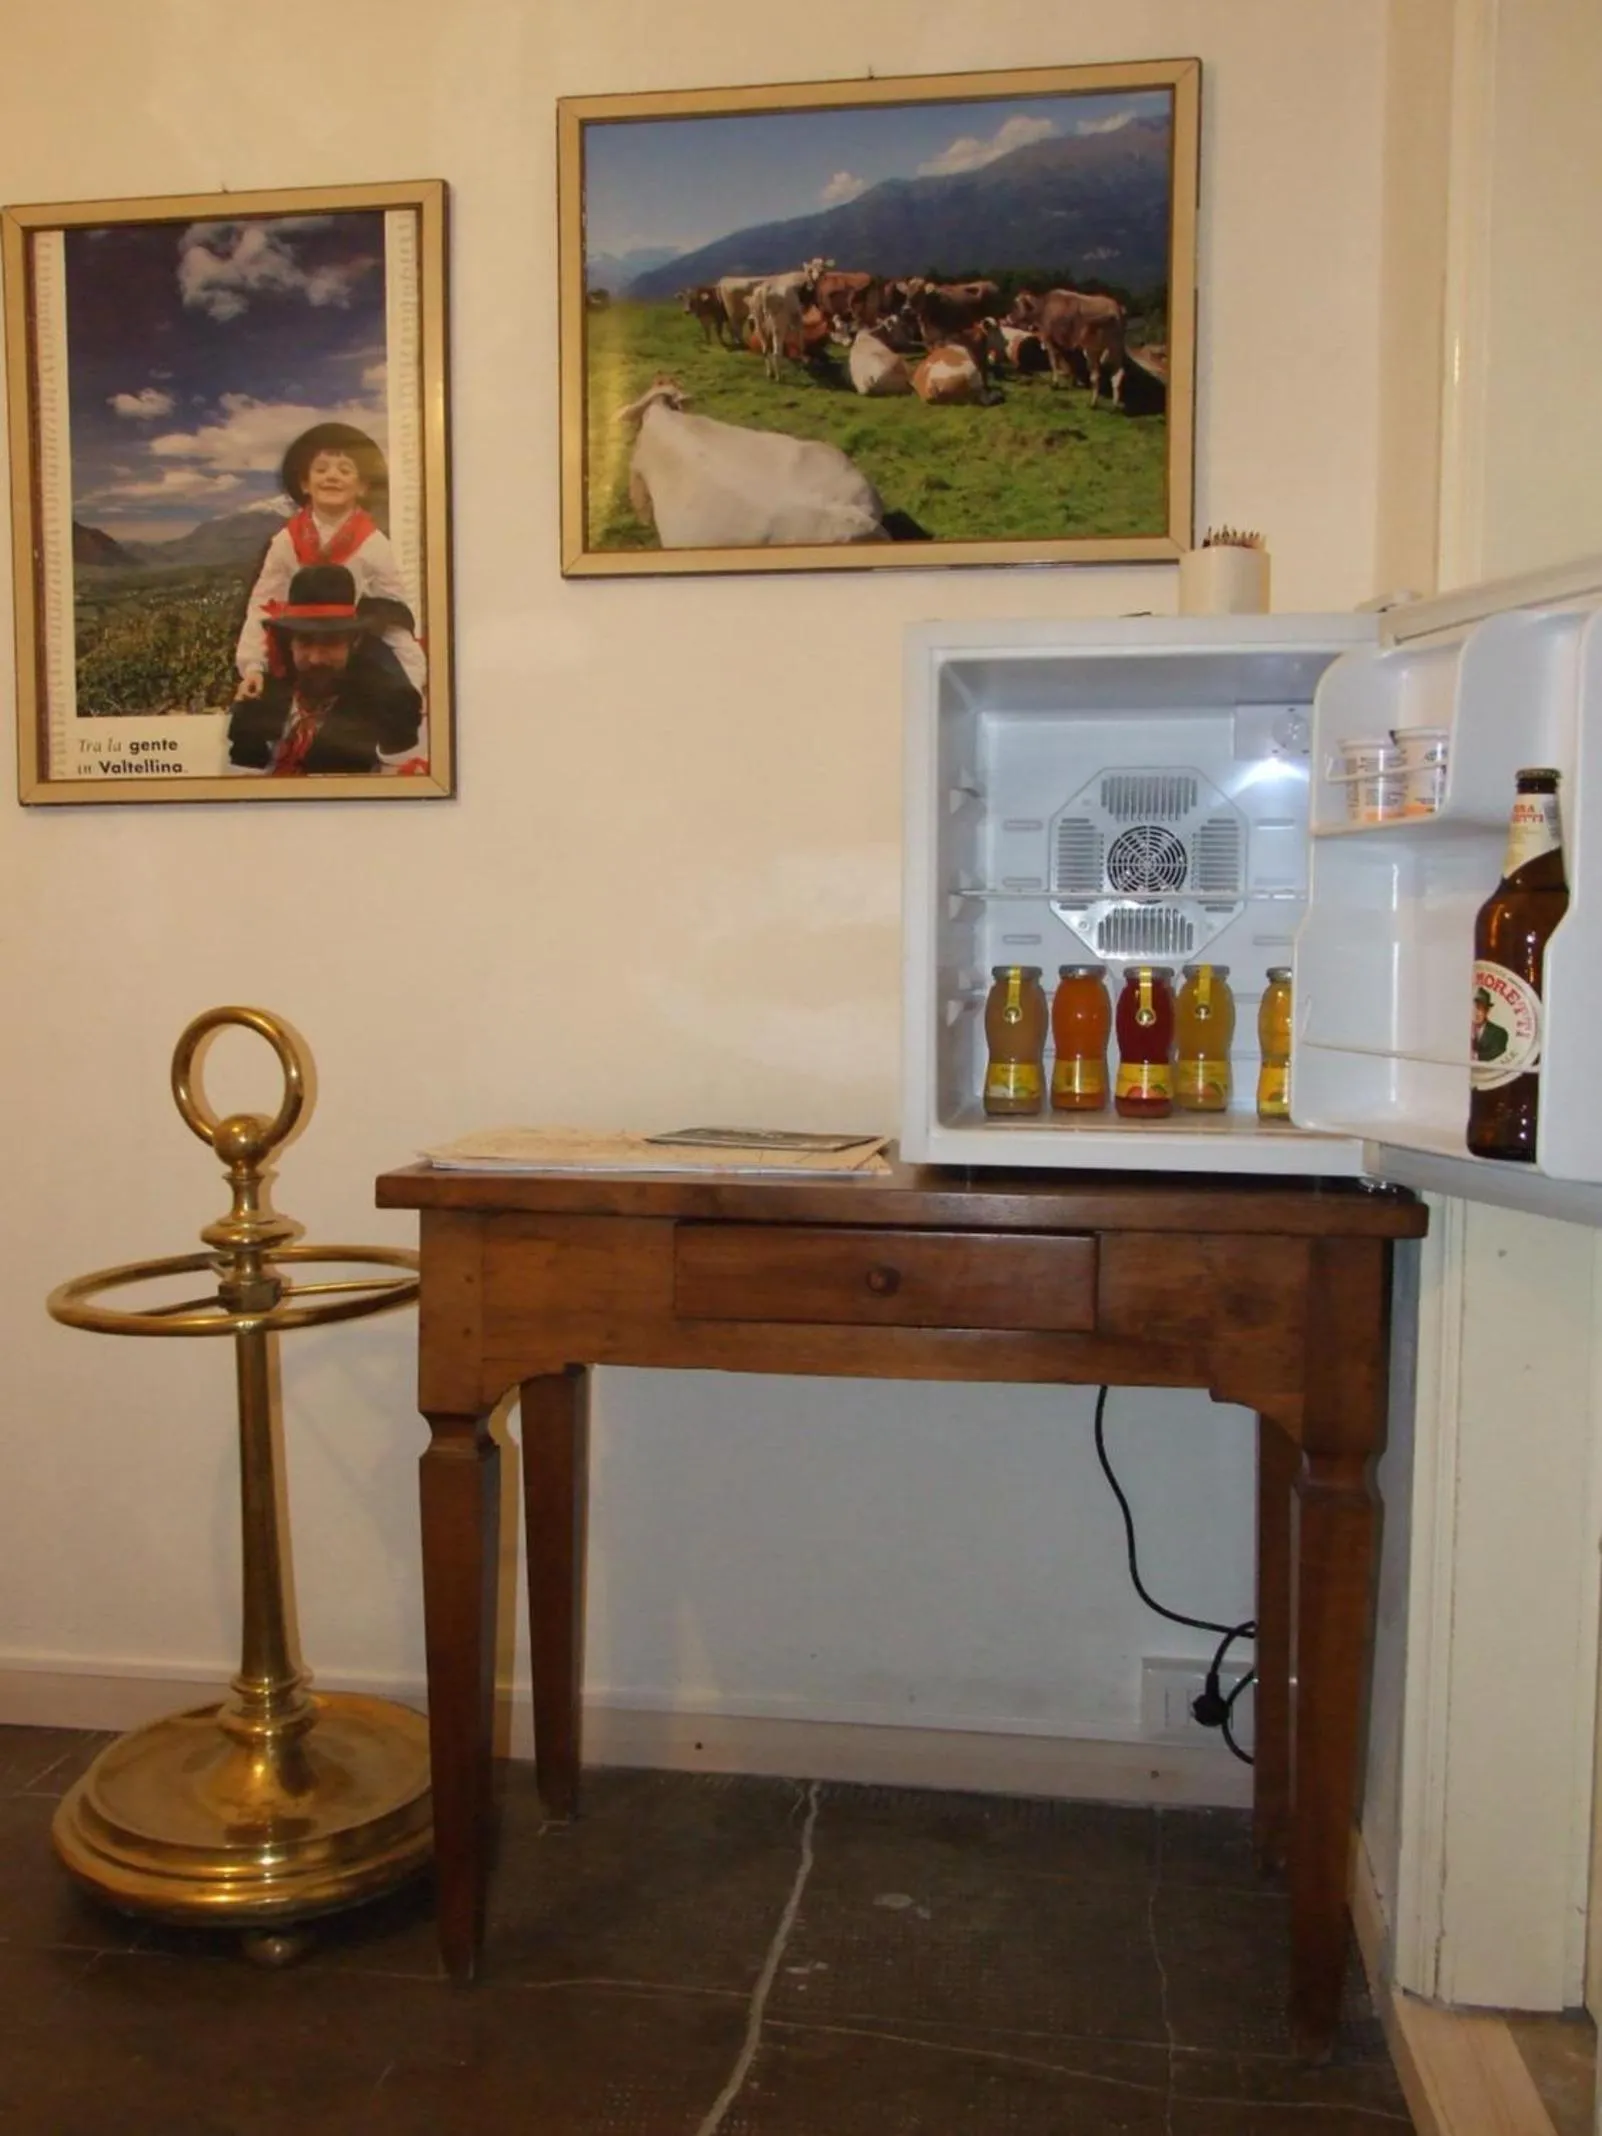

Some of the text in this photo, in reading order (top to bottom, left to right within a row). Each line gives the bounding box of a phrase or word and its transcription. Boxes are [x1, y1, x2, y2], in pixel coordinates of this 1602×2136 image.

[79, 738, 178, 755] Tra la gente
[77, 763, 92, 775] in
